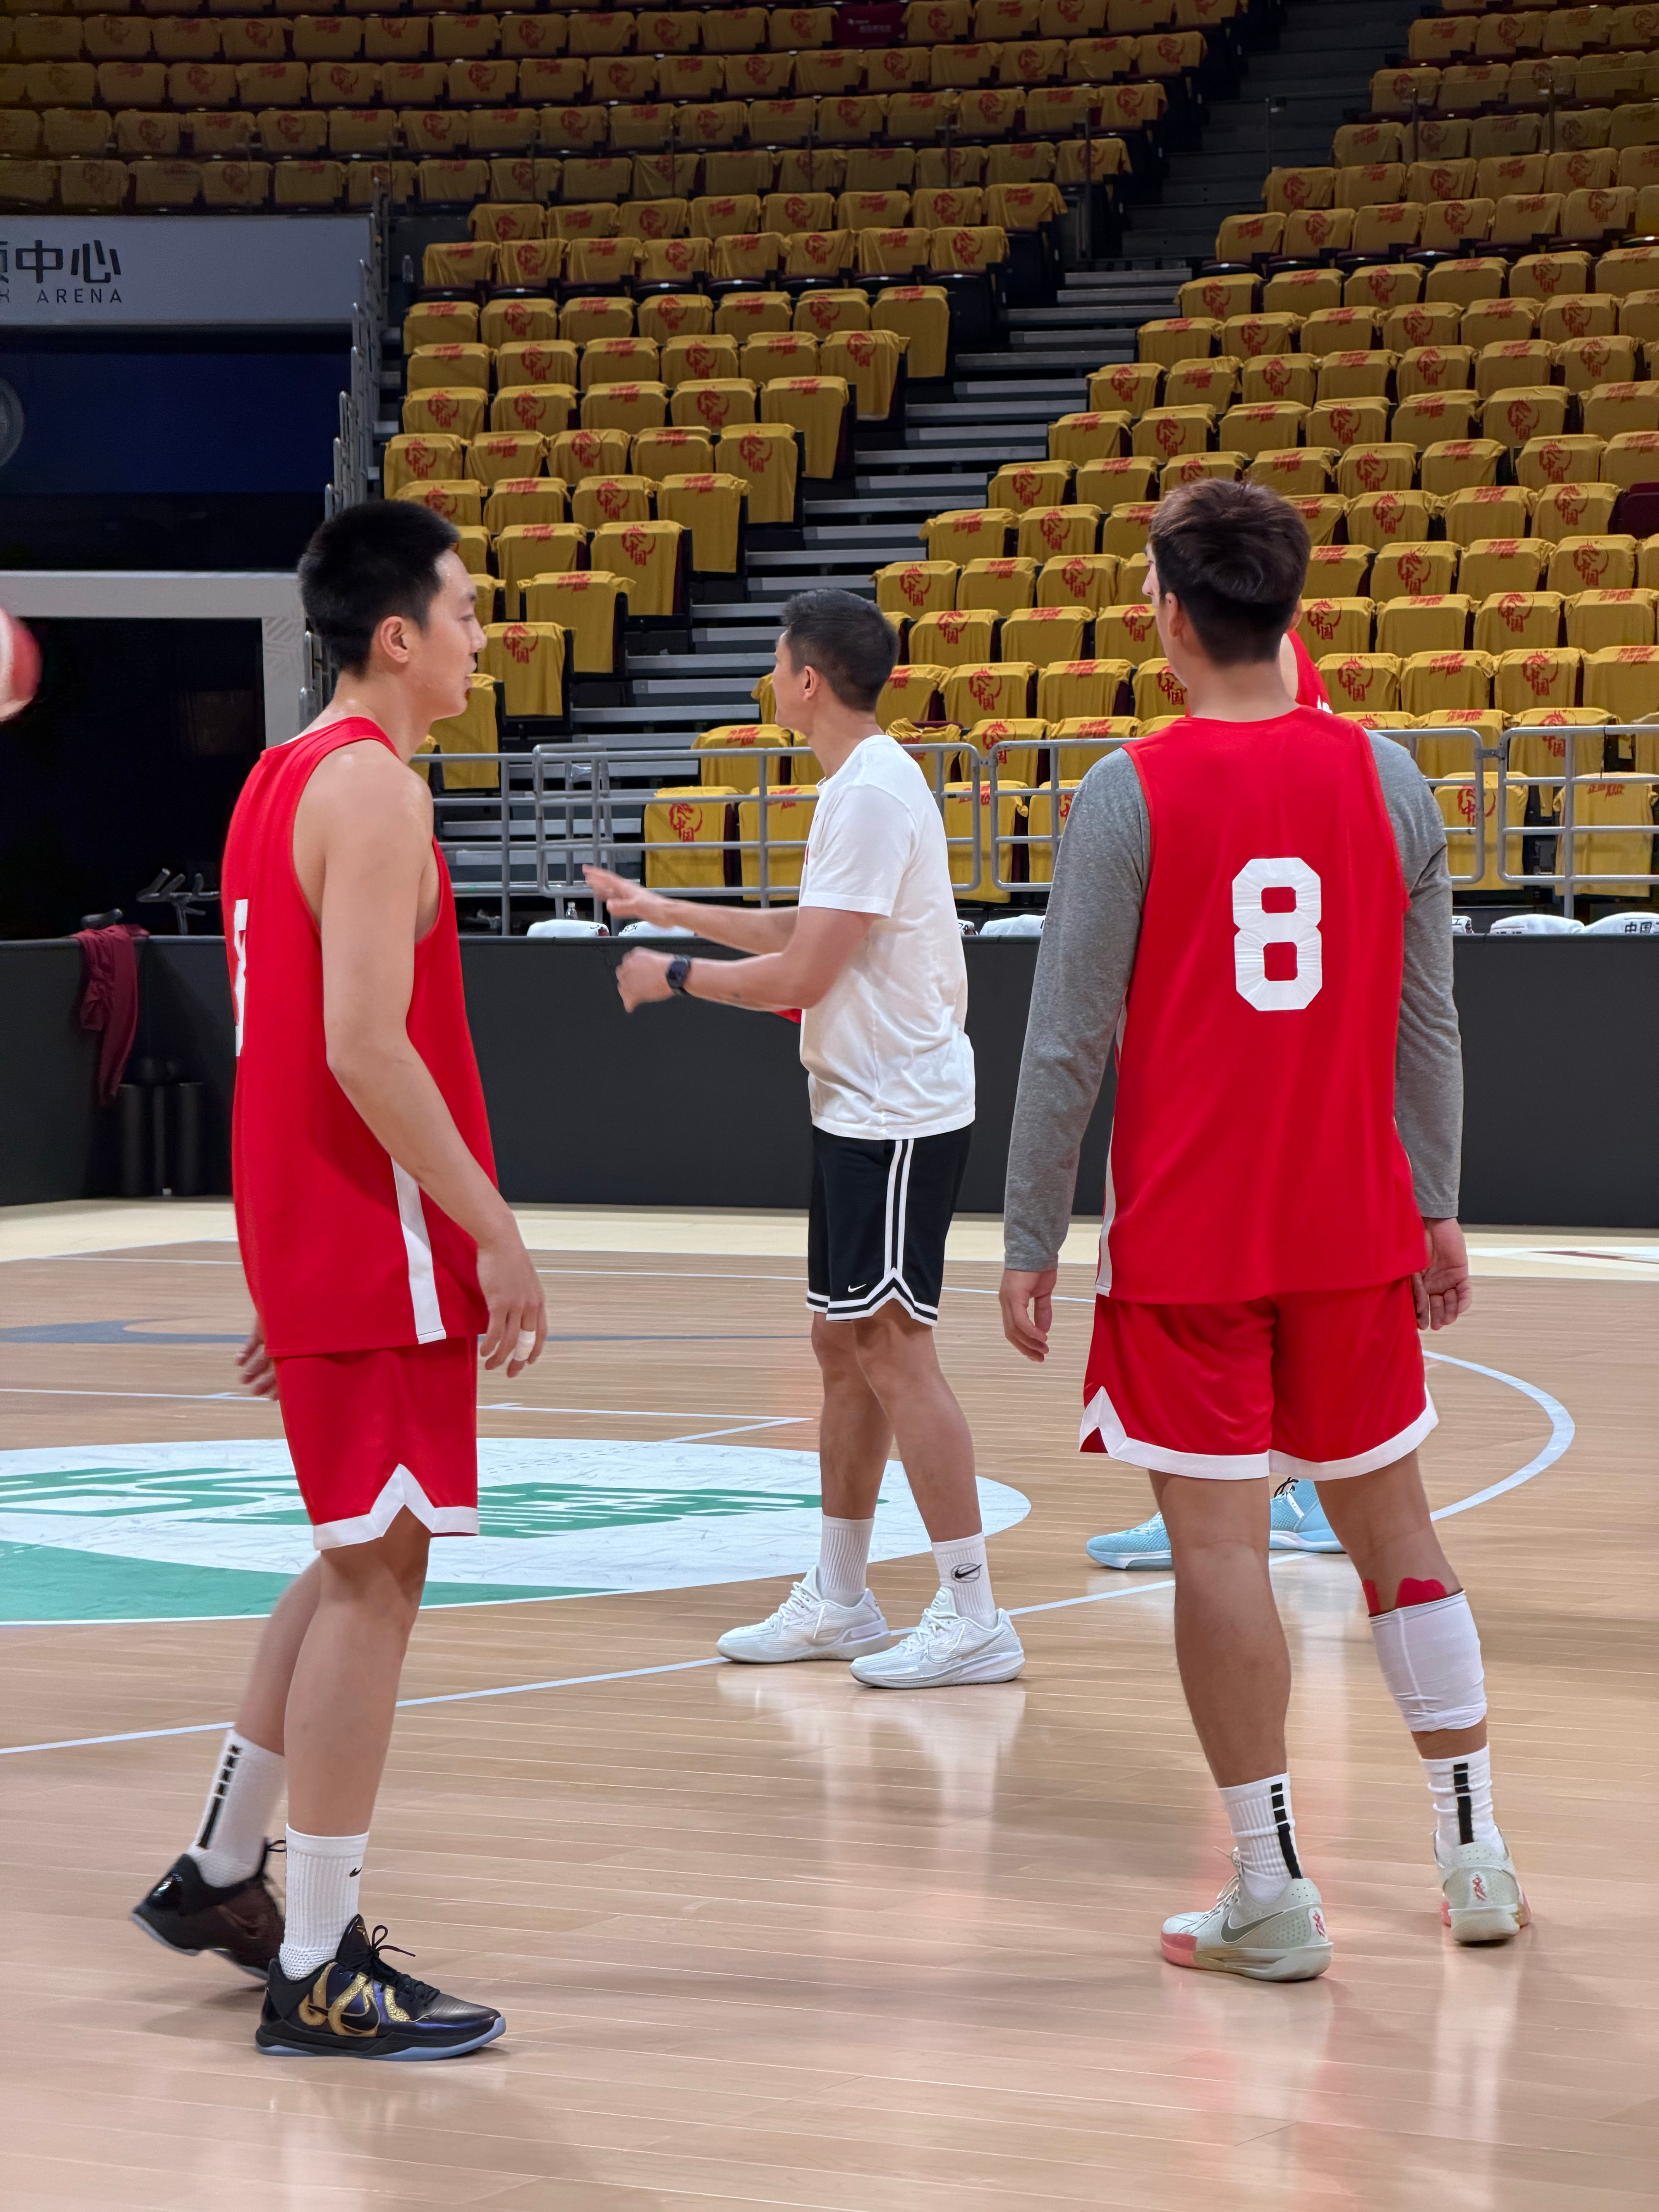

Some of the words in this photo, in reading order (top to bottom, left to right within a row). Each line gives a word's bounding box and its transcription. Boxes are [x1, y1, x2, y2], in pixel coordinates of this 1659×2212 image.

[37, 289, 122, 303] ARENA
[1312, 613, 1334, 640] 中国
[973, 682, 994, 710] 中国
[1161, 678, 1183, 705] 中国
[673, 816, 694, 842] 中国
[1232, 857, 1322, 1011] 8
[1624, 921, 1659, 934] 中国
